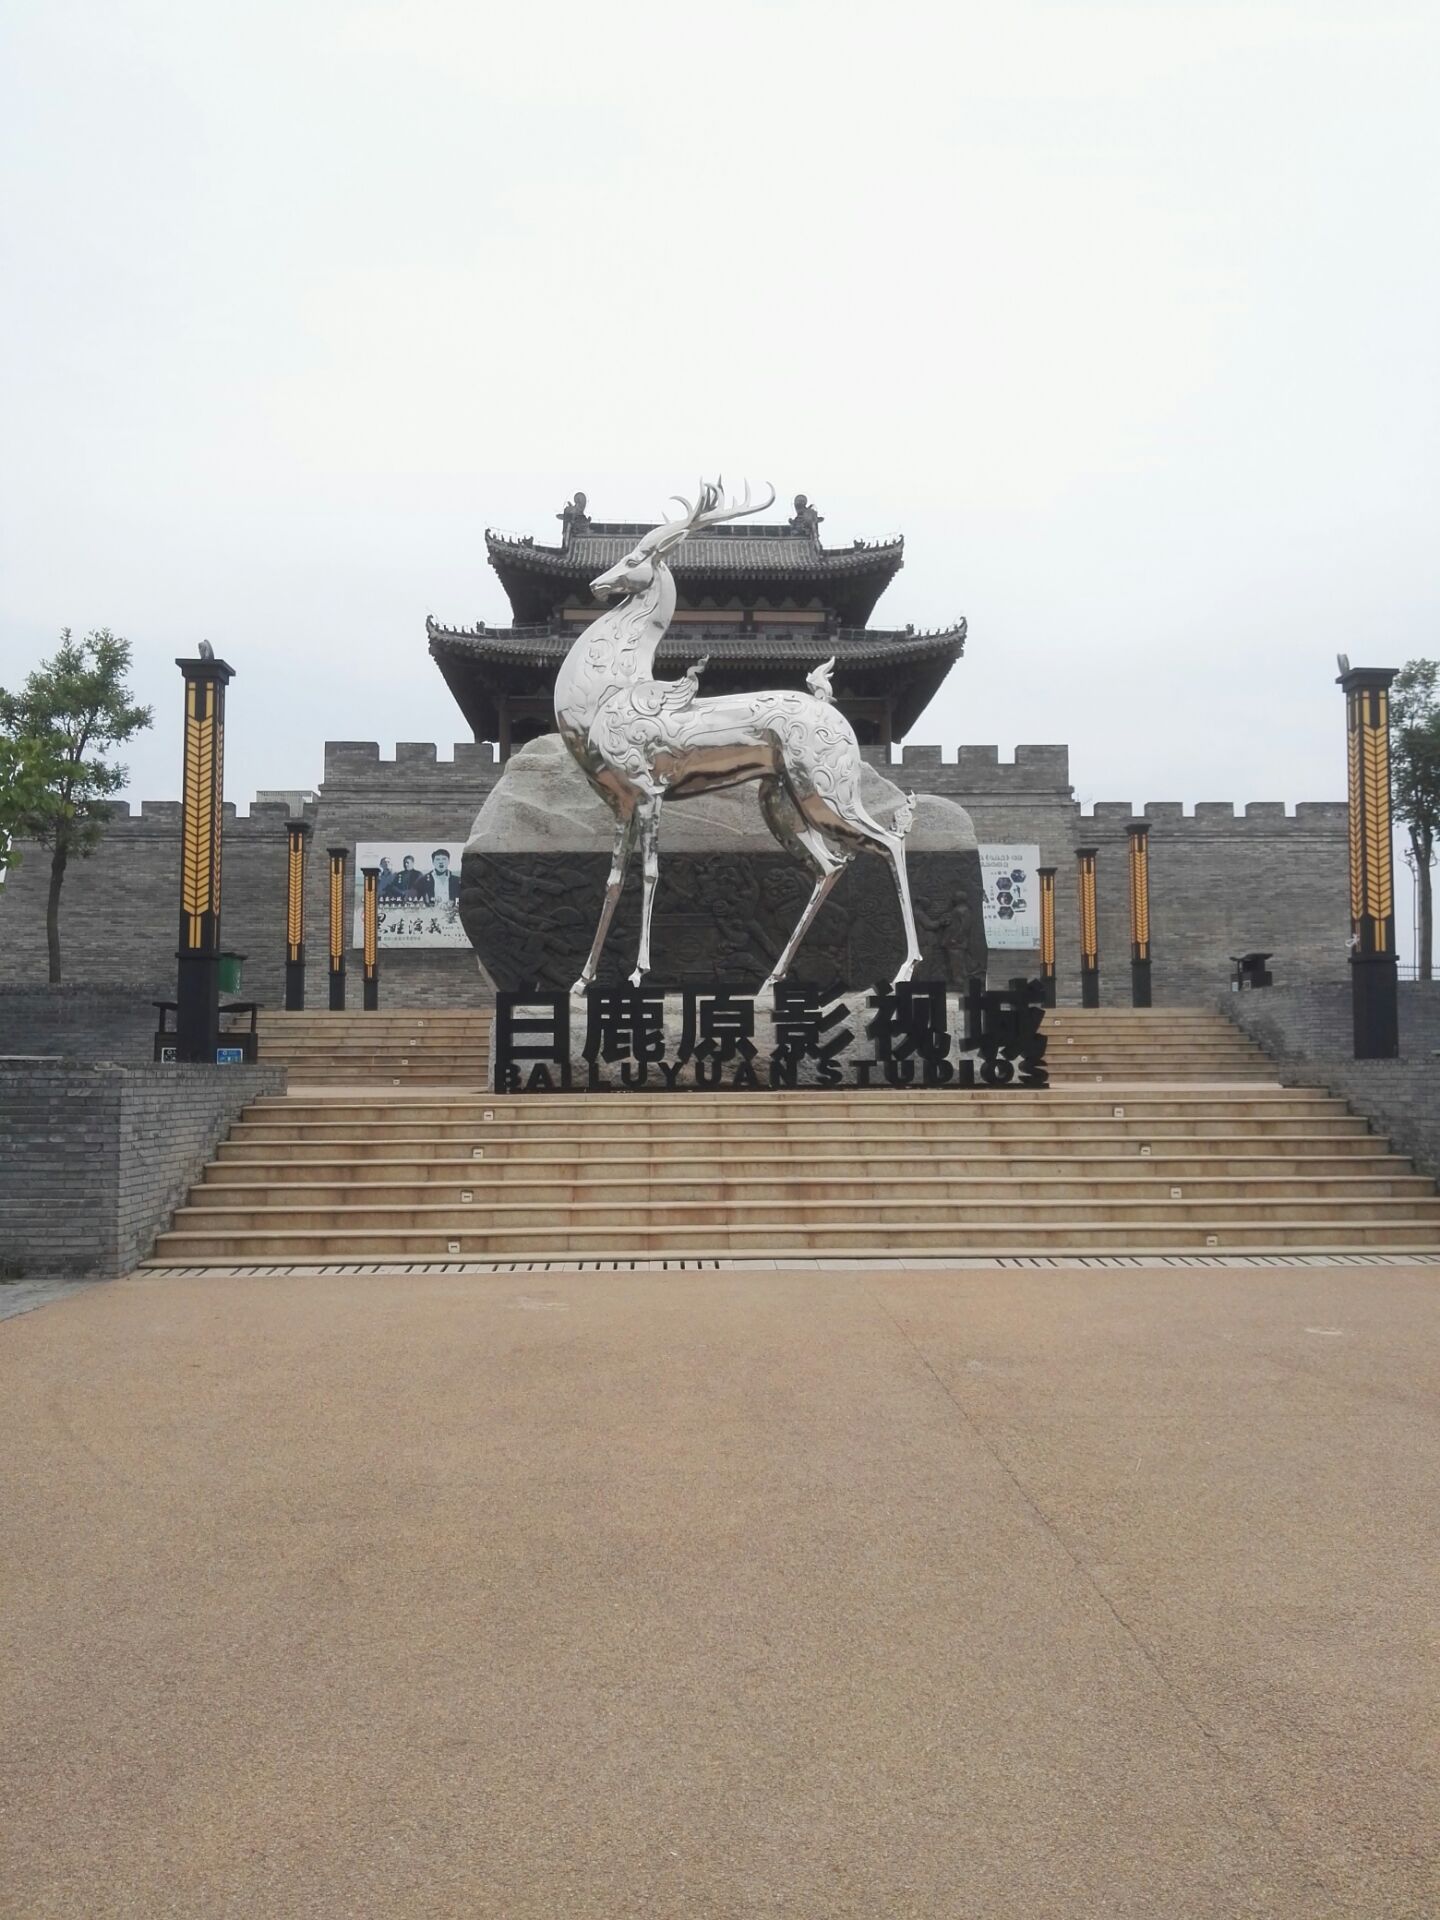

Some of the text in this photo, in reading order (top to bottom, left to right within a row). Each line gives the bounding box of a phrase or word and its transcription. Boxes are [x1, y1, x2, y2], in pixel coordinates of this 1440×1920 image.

[495, 978, 1047, 1063] 白鹿原影视城
[495, 1059, 1049, 1089] BAI LUYUAN STUDIOS
